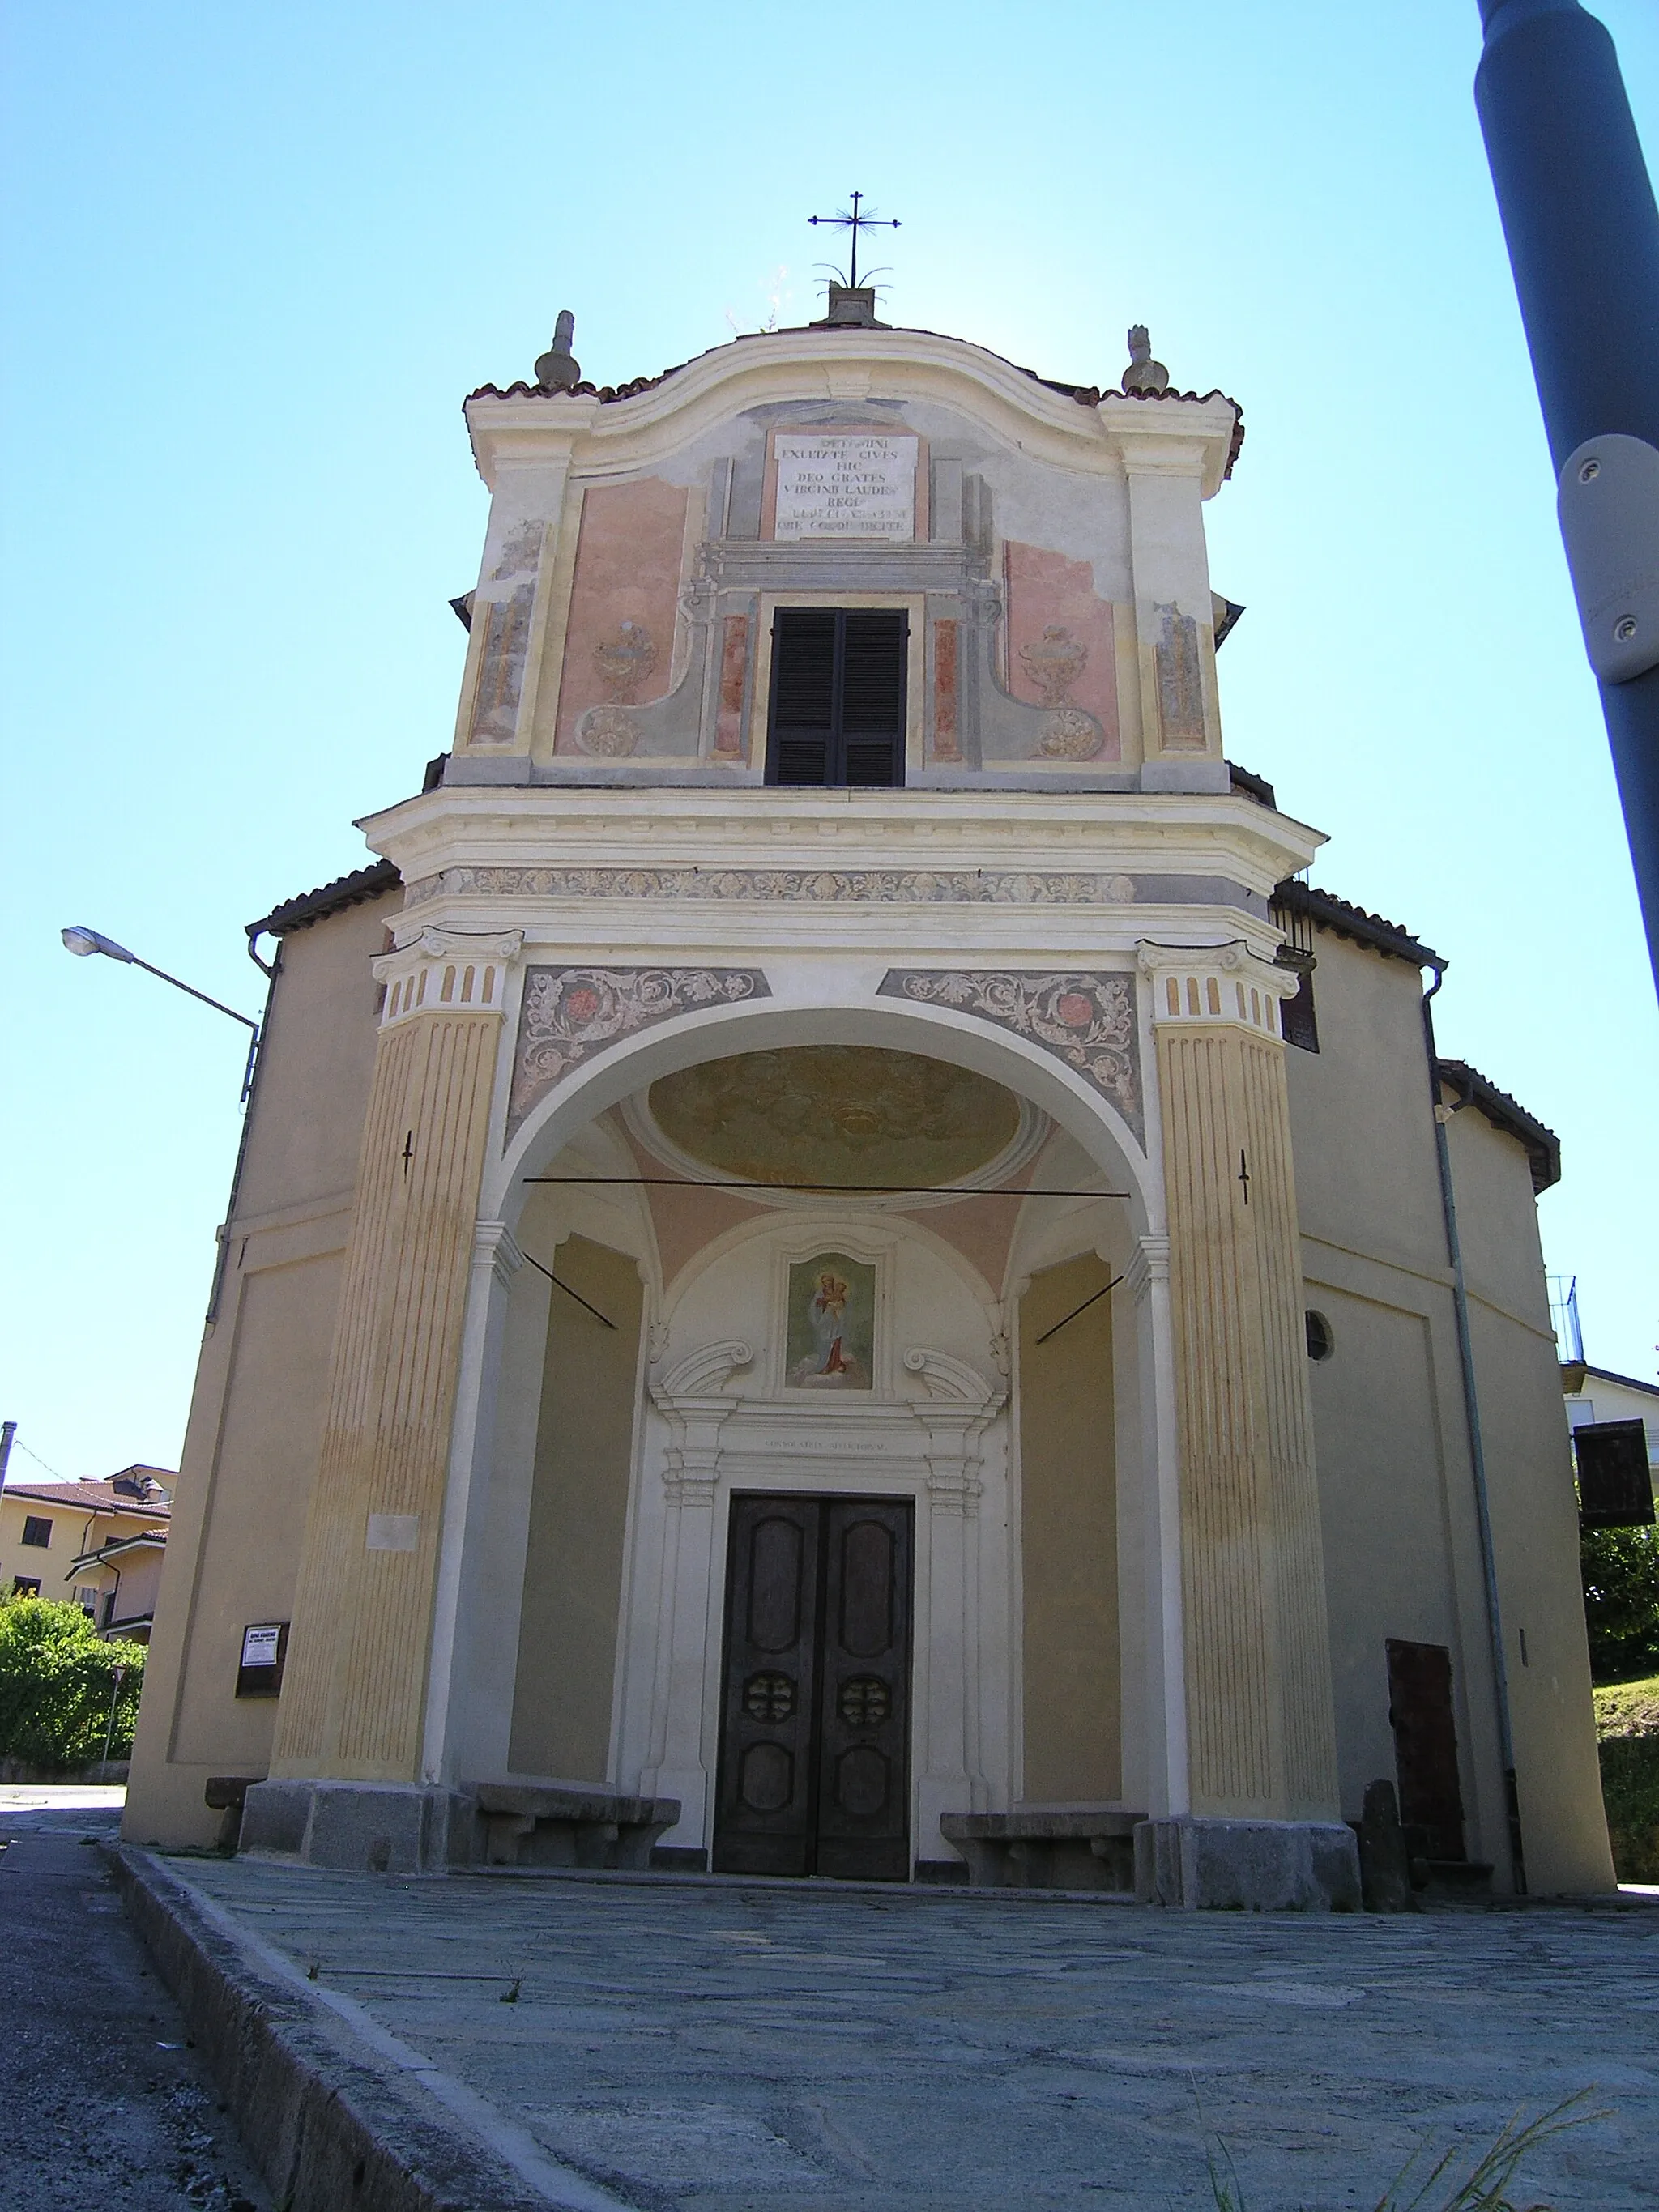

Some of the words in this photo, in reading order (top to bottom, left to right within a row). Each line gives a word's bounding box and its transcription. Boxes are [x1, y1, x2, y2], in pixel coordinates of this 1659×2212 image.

[859, 450, 898, 459] CIVES
[837, 462, 862, 471] HIC
[797, 472, 824, 482] DEO
[831, 473, 885, 483] GRATES
